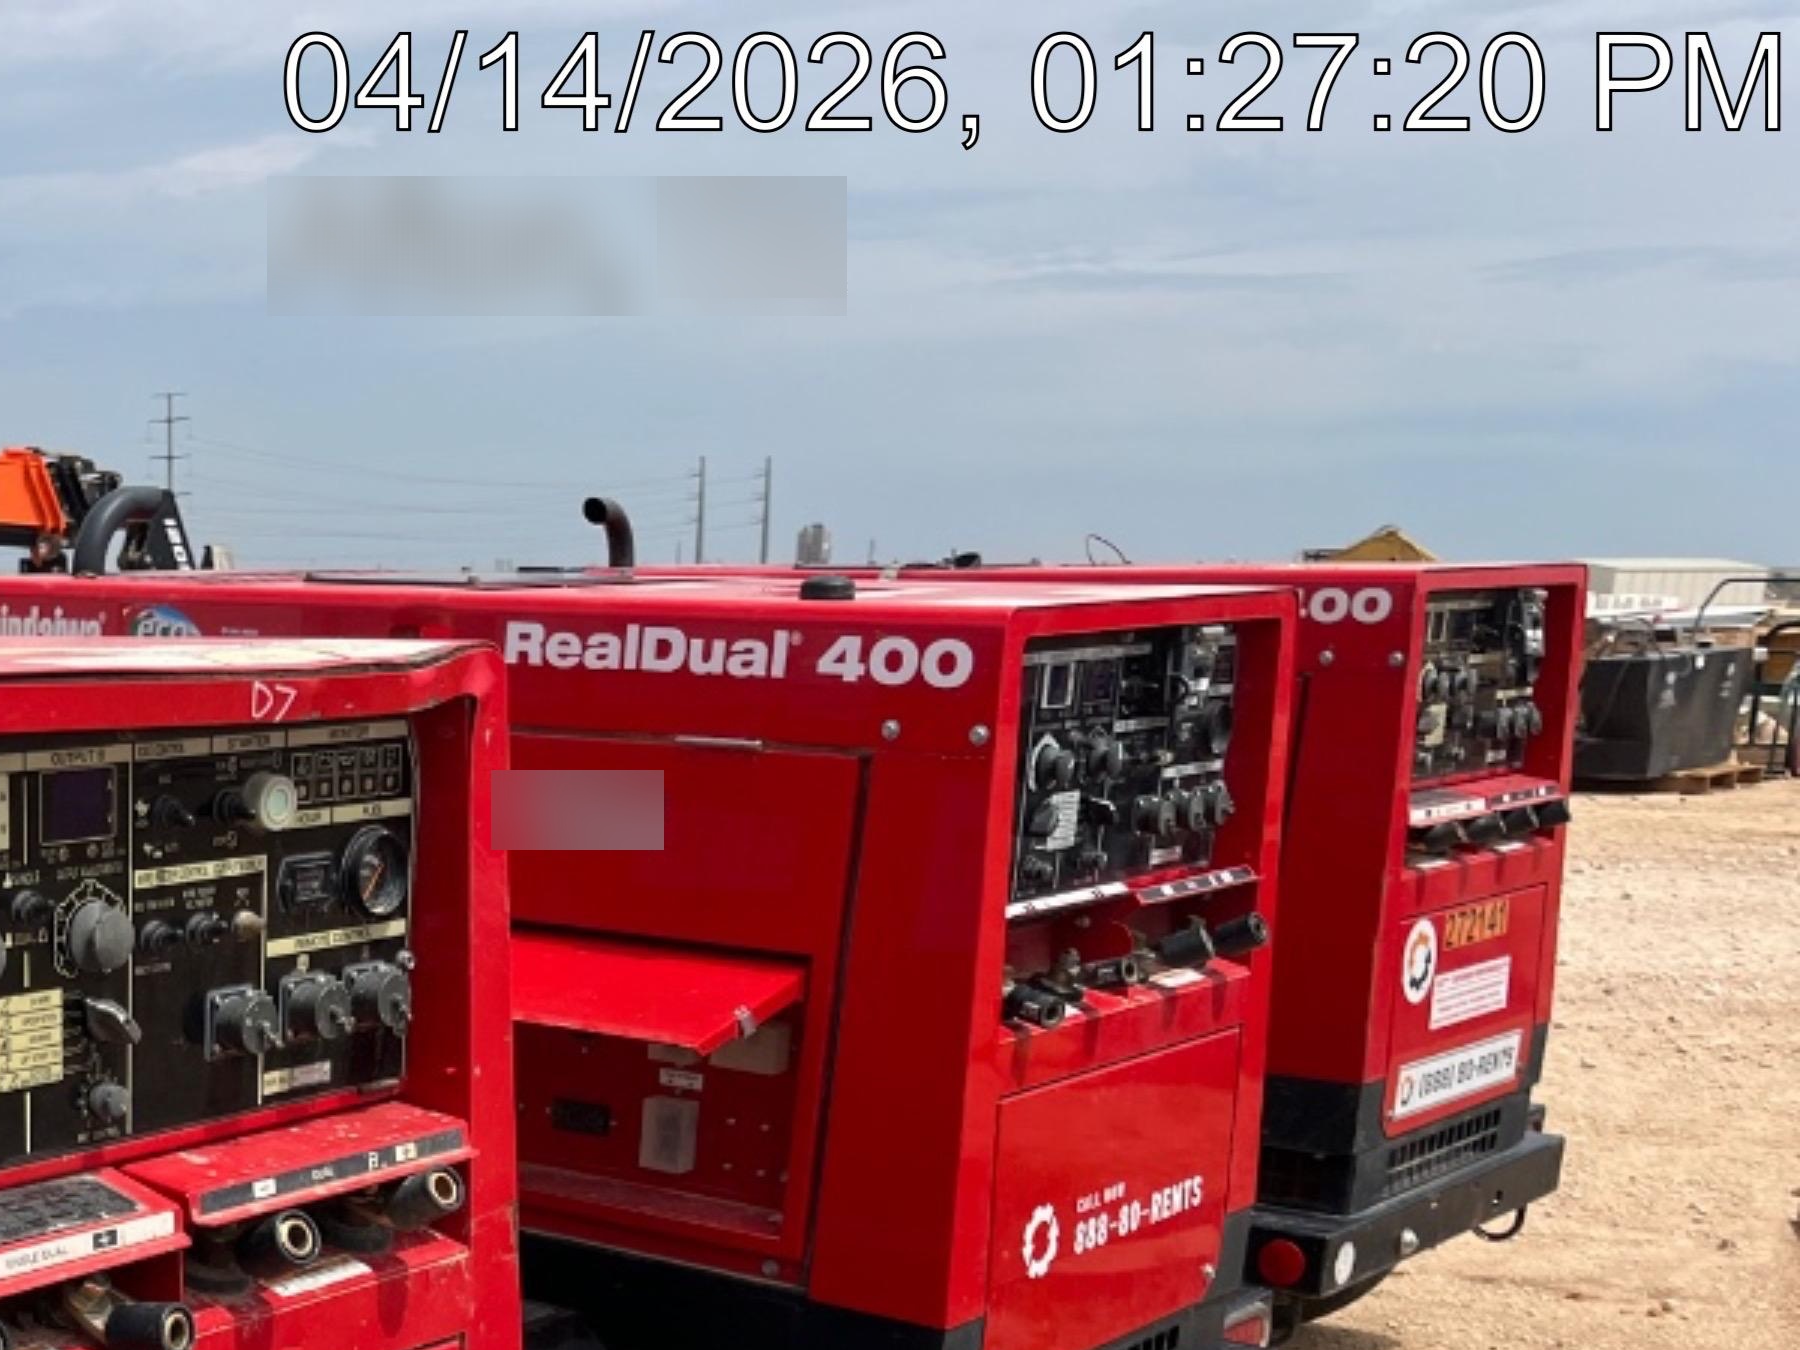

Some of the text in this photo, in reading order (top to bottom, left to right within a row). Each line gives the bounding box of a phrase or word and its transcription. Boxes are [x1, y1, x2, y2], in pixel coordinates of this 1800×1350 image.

[1298, 586, 1394, 624] 00
[816, 634, 974, 688] 400
[251, 682, 298, 724] D7
[50, 750, 95, 766] OUTPUT
[1073, 1174, 1204, 1255] 888-80-RENTS
